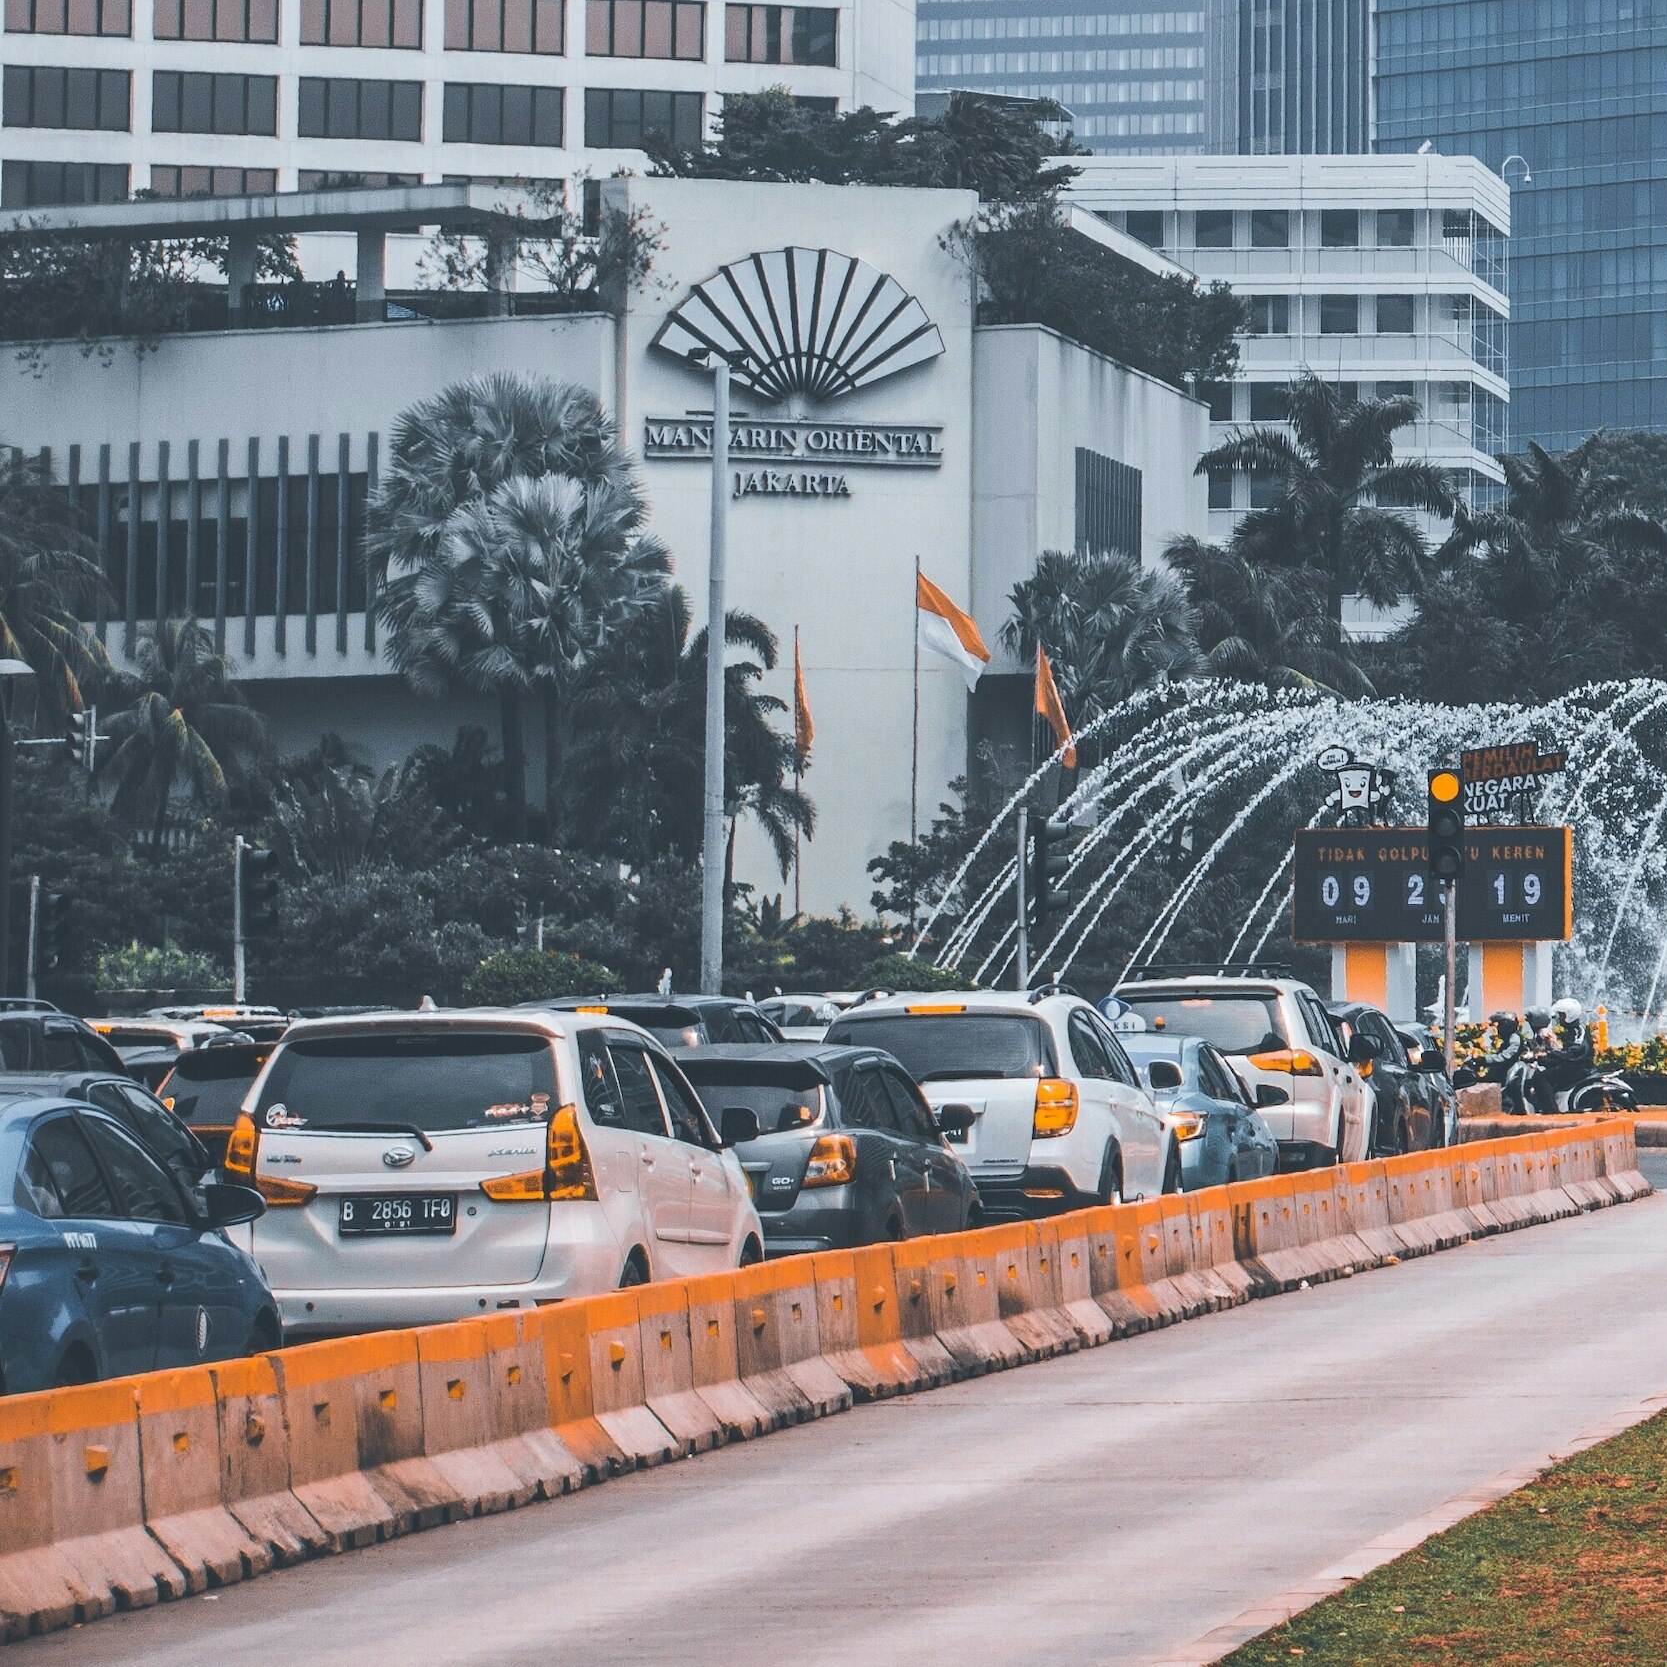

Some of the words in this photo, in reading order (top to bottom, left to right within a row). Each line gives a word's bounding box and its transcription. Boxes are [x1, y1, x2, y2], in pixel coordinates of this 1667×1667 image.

[646, 425, 800, 449] MANARIN
[807, 430, 944, 454] ORIENTAL
[735, 471, 852, 497] JAKARTA
[1464, 774, 1536, 798] NEGARA
[1318, 847, 1366, 862] TIDAK
[1378, 846, 1429, 861] GOLPU
[1491, 845, 1545, 860] KEREN
[1113, 1022, 1136, 1030] KSI
[343, 1201, 354, 1222] B
[372, 1200, 412, 1220] 2856
